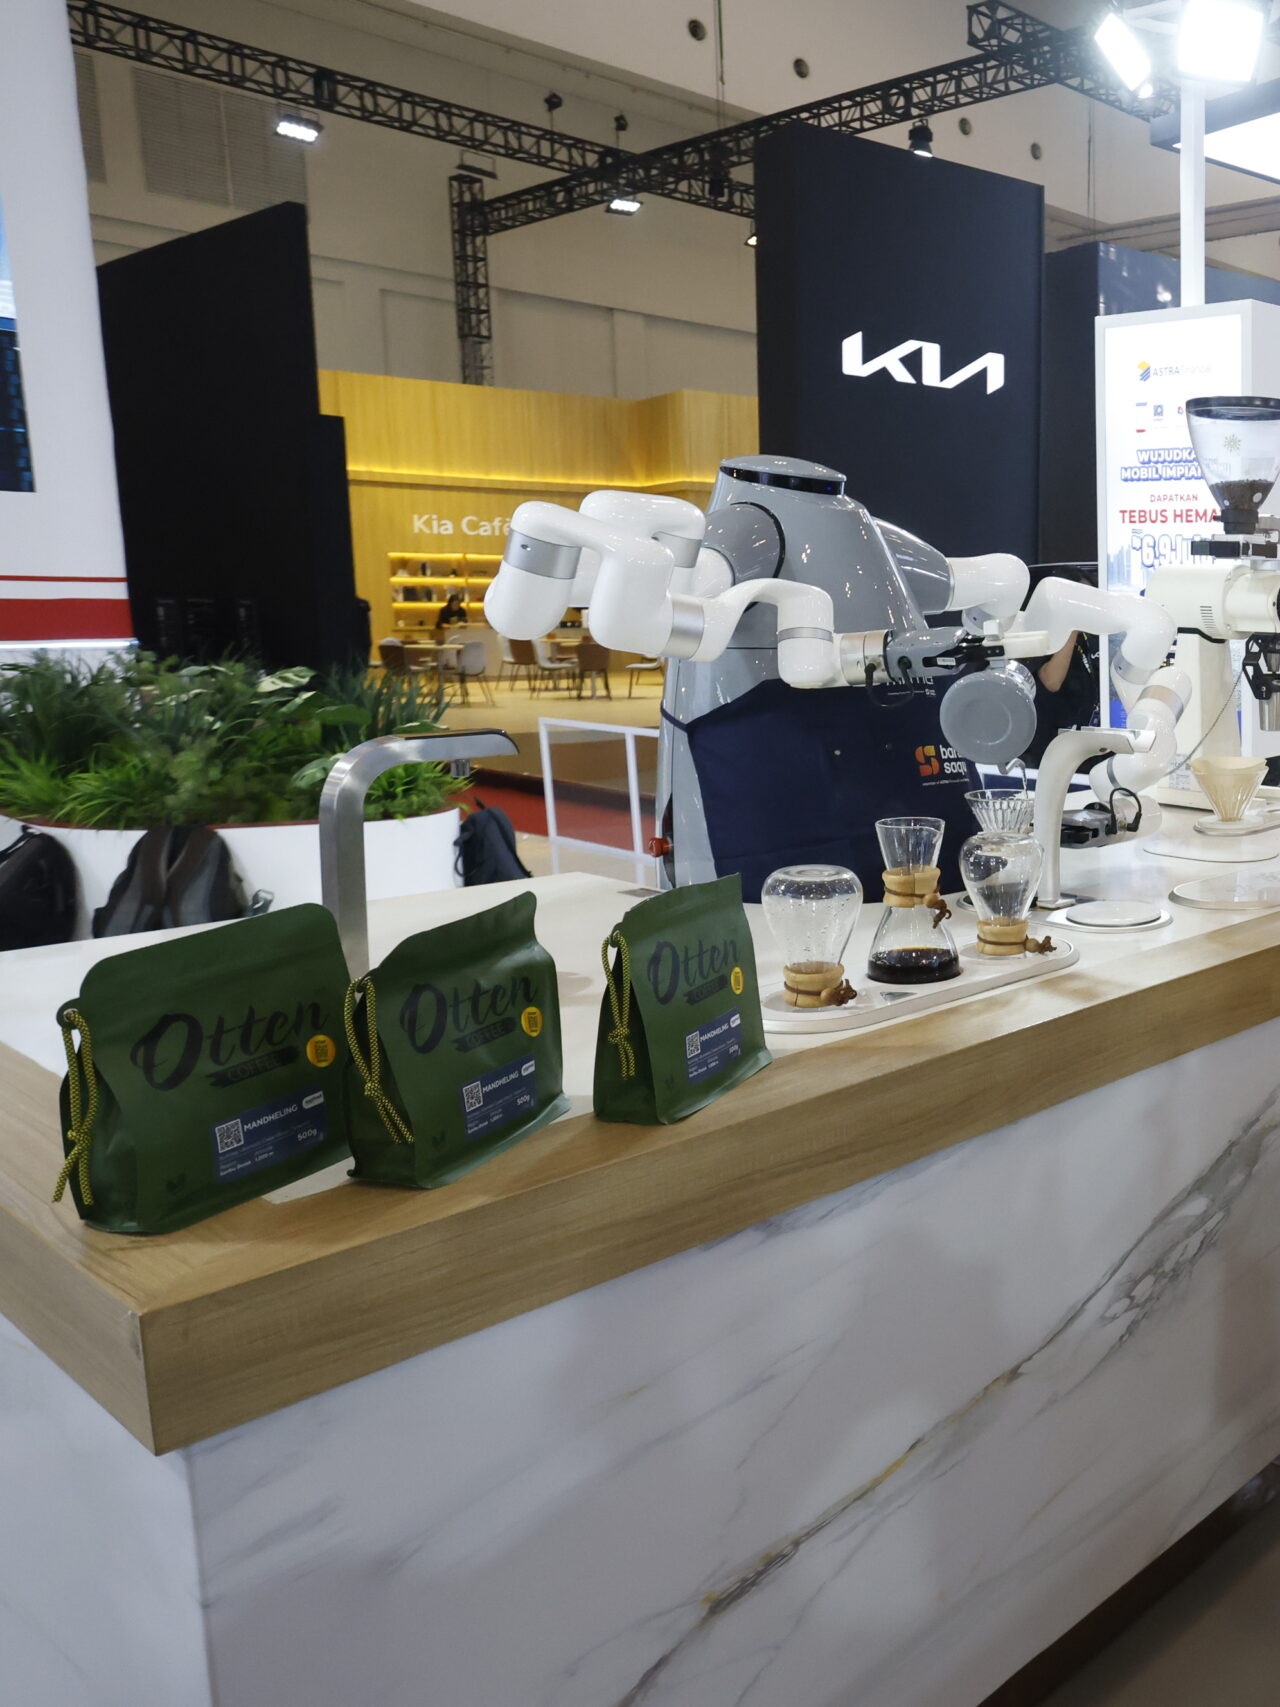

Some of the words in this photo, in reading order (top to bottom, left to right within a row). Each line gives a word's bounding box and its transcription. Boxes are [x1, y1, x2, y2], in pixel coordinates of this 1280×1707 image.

[842, 331, 1004, 395] KIA
[1136, 447, 1197, 465] WUJUDKA
[1120, 466, 1162, 482] MOBIL
[1162, 464, 1206, 480] IMPIA
[1150, 494, 1198, 503] DAPATKAN
[412, 514, 454, 534] Kia
[1119, 509, 1168, 524] TEBUS
[1173, 508, 1219, 523] HEMA
[647, 938, 739, 1005] Otten
[399, 976, 538, 1054] Otten
[130, 1002, 330, 1091] Otten
[482, 1070, 520, 1093] MANDHELING
[243, 1104, 299, 1132] MANDHELING
[297, 1128, 318, 1141] 500g
